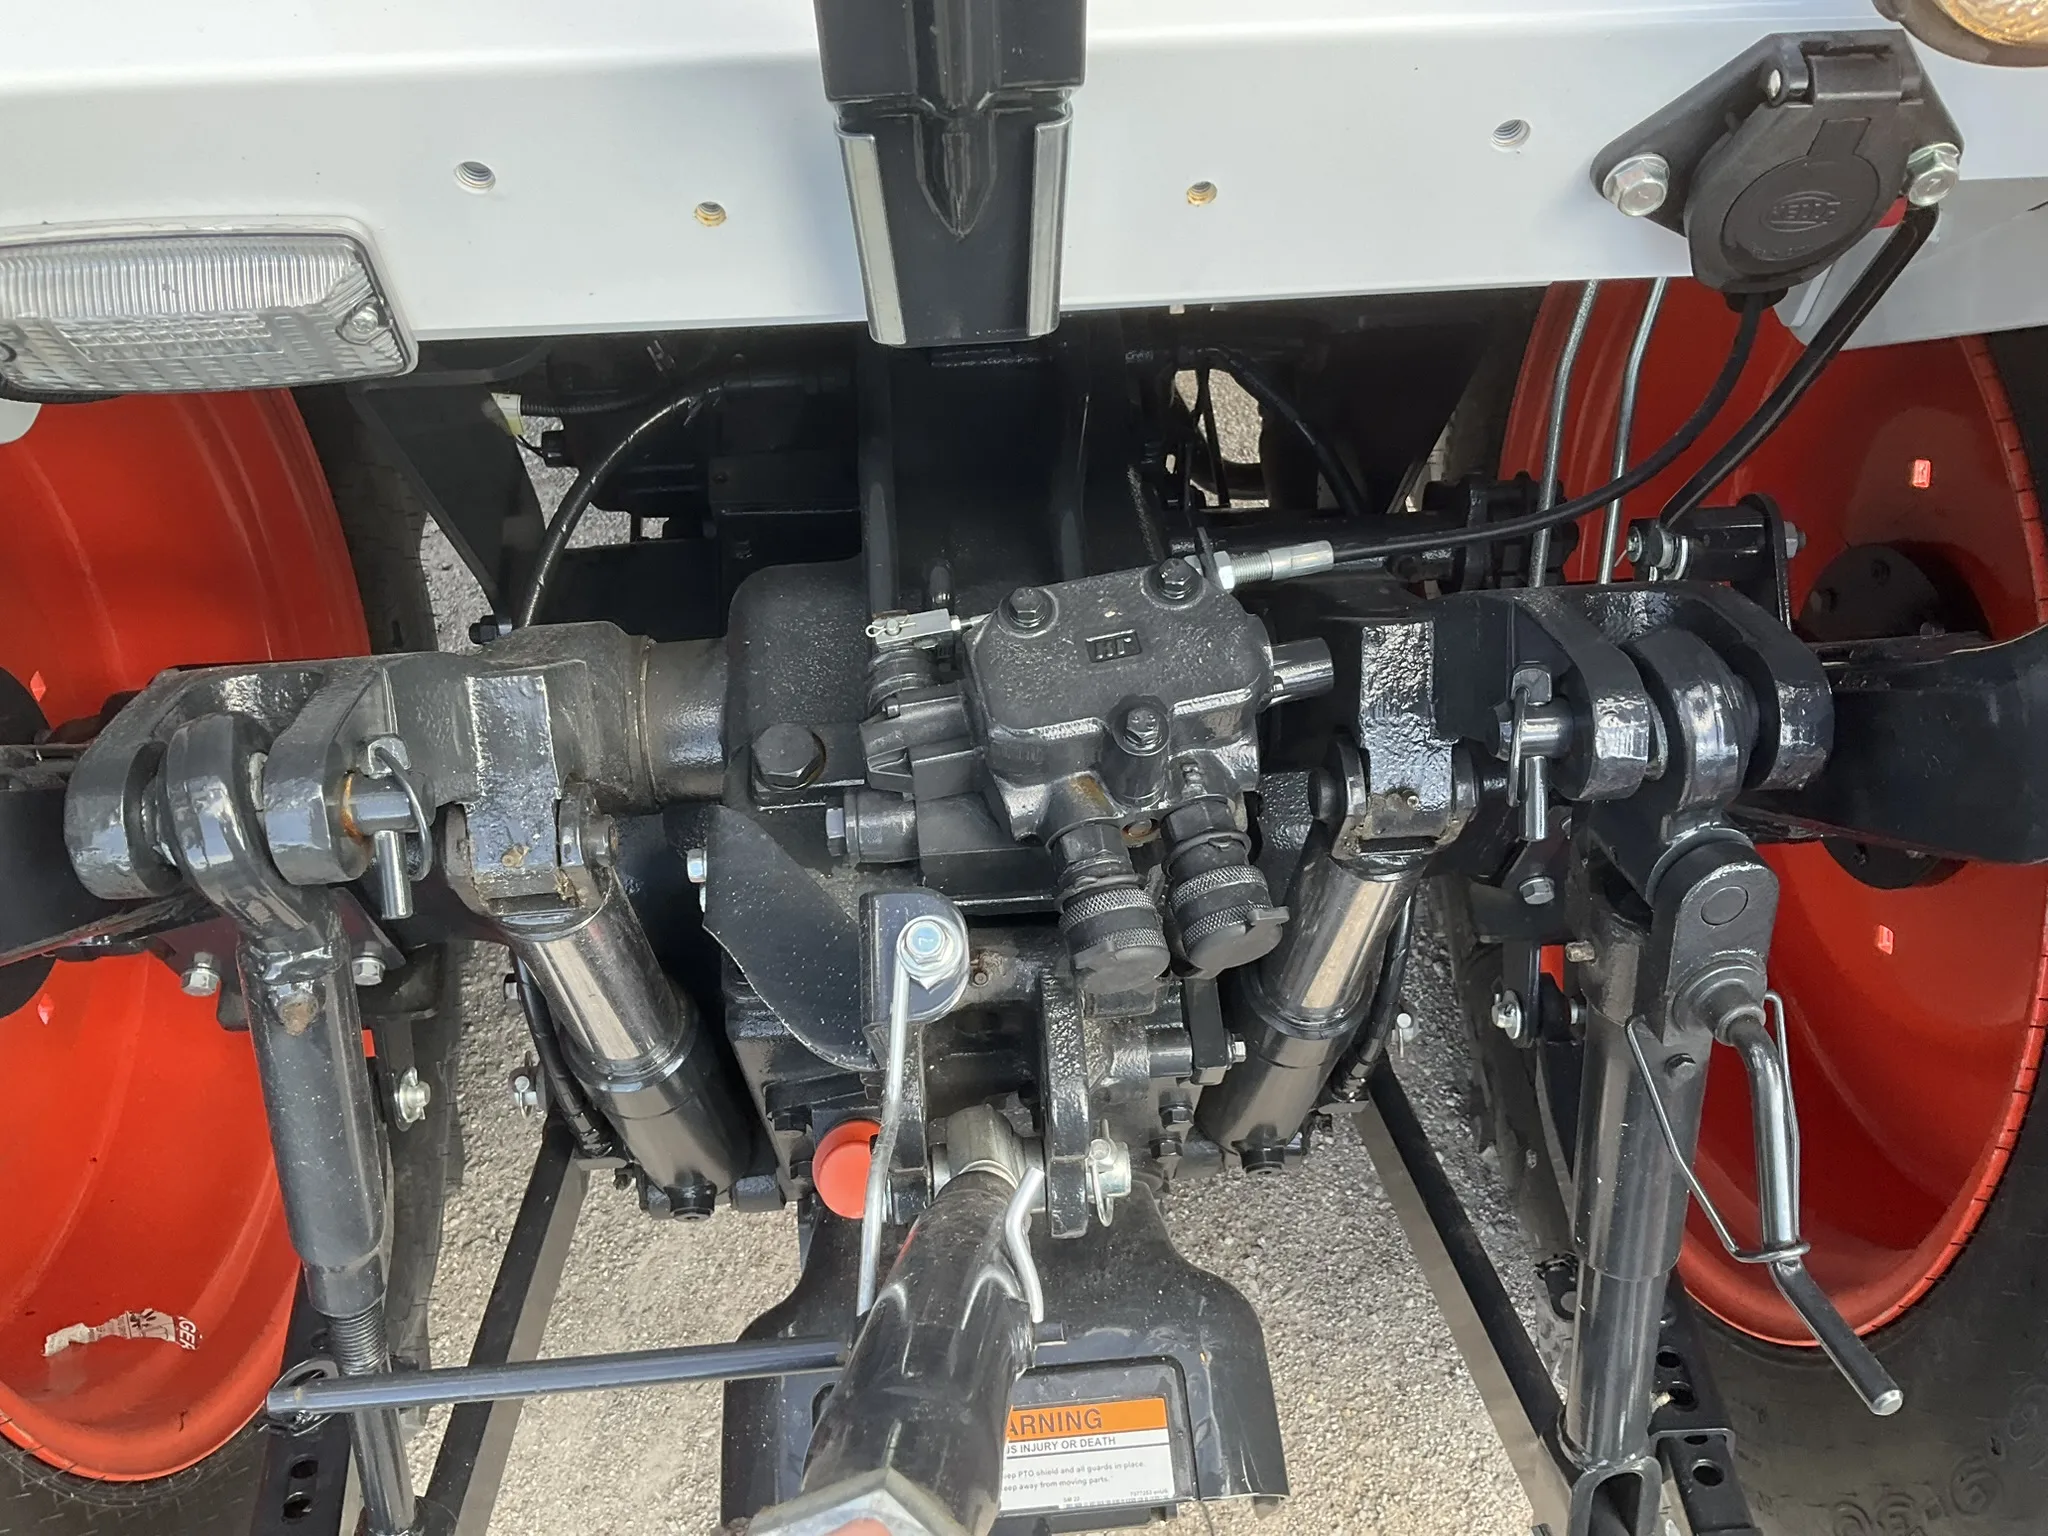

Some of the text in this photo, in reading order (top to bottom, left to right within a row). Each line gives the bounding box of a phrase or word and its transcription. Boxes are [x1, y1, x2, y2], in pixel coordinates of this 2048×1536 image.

[1009, 1408, 1102, 1436] ARNING
[1020, 1441, 1058, 1453] INJURY
[1061, 1440, 1077, 1449] OR
[1080, 1436, 1116, 1448] DEATH
[1018, 1470, 1035, 1478] PTO
[1036, 1467, 1059, 1477] shield
[1060, 1466, 1074, 1474] and
[1076, 1465, 1086, 1473] all
[1087, 1463, 1113, 1473] guards
[1115, 1461, 1122, 1470] in
[1019, 1482, 1038, 1491] away
[1040, 1480, 1058, 1488] from
[1059, 1477, 1087, 1487] moving
